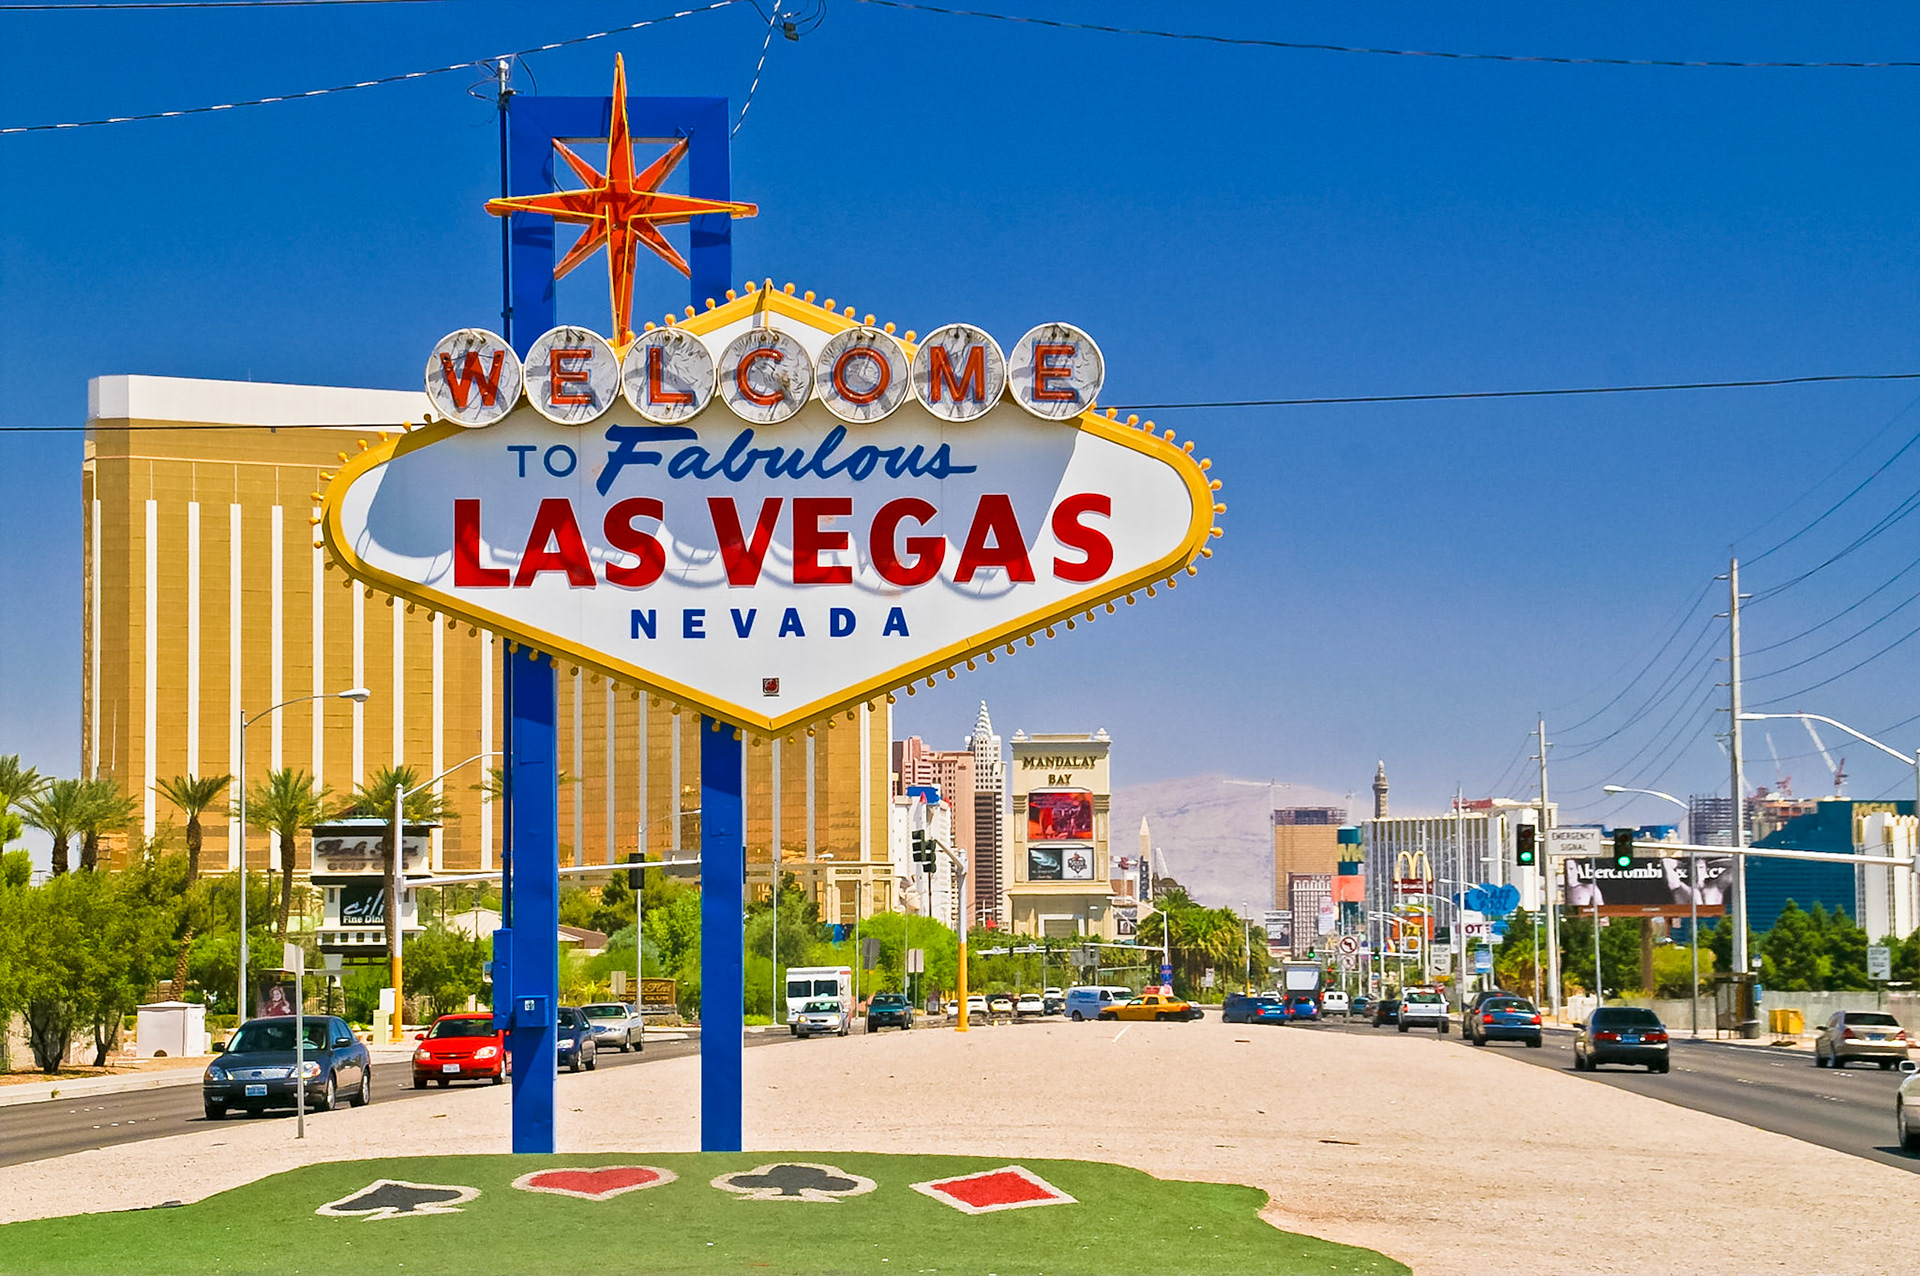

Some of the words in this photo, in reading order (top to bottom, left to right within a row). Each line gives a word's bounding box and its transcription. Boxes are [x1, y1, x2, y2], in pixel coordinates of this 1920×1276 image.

[438, 343, 1078, 408] WELCOME
[506, 445, 577, 477] TO
[596, 424, 977, 496] Fabulous
[454, 497, 666, 589] LAS
[707, 493, 1113, 588] VEGAS
[630, 606, 911, 639] NEVADA
[1023, 756, 1098, 769] MANDALAY
[1048, 773, 1072, 785] BAY
[1552, 832, 1595, 841] EMERGENCY
[1560, 843, 1588, 851] SIGNAL
[1575, 863, 1663, 879] Abercrombi
[343, 915, 363, 924] Fine
[364, 915, 384, 924] Dini
